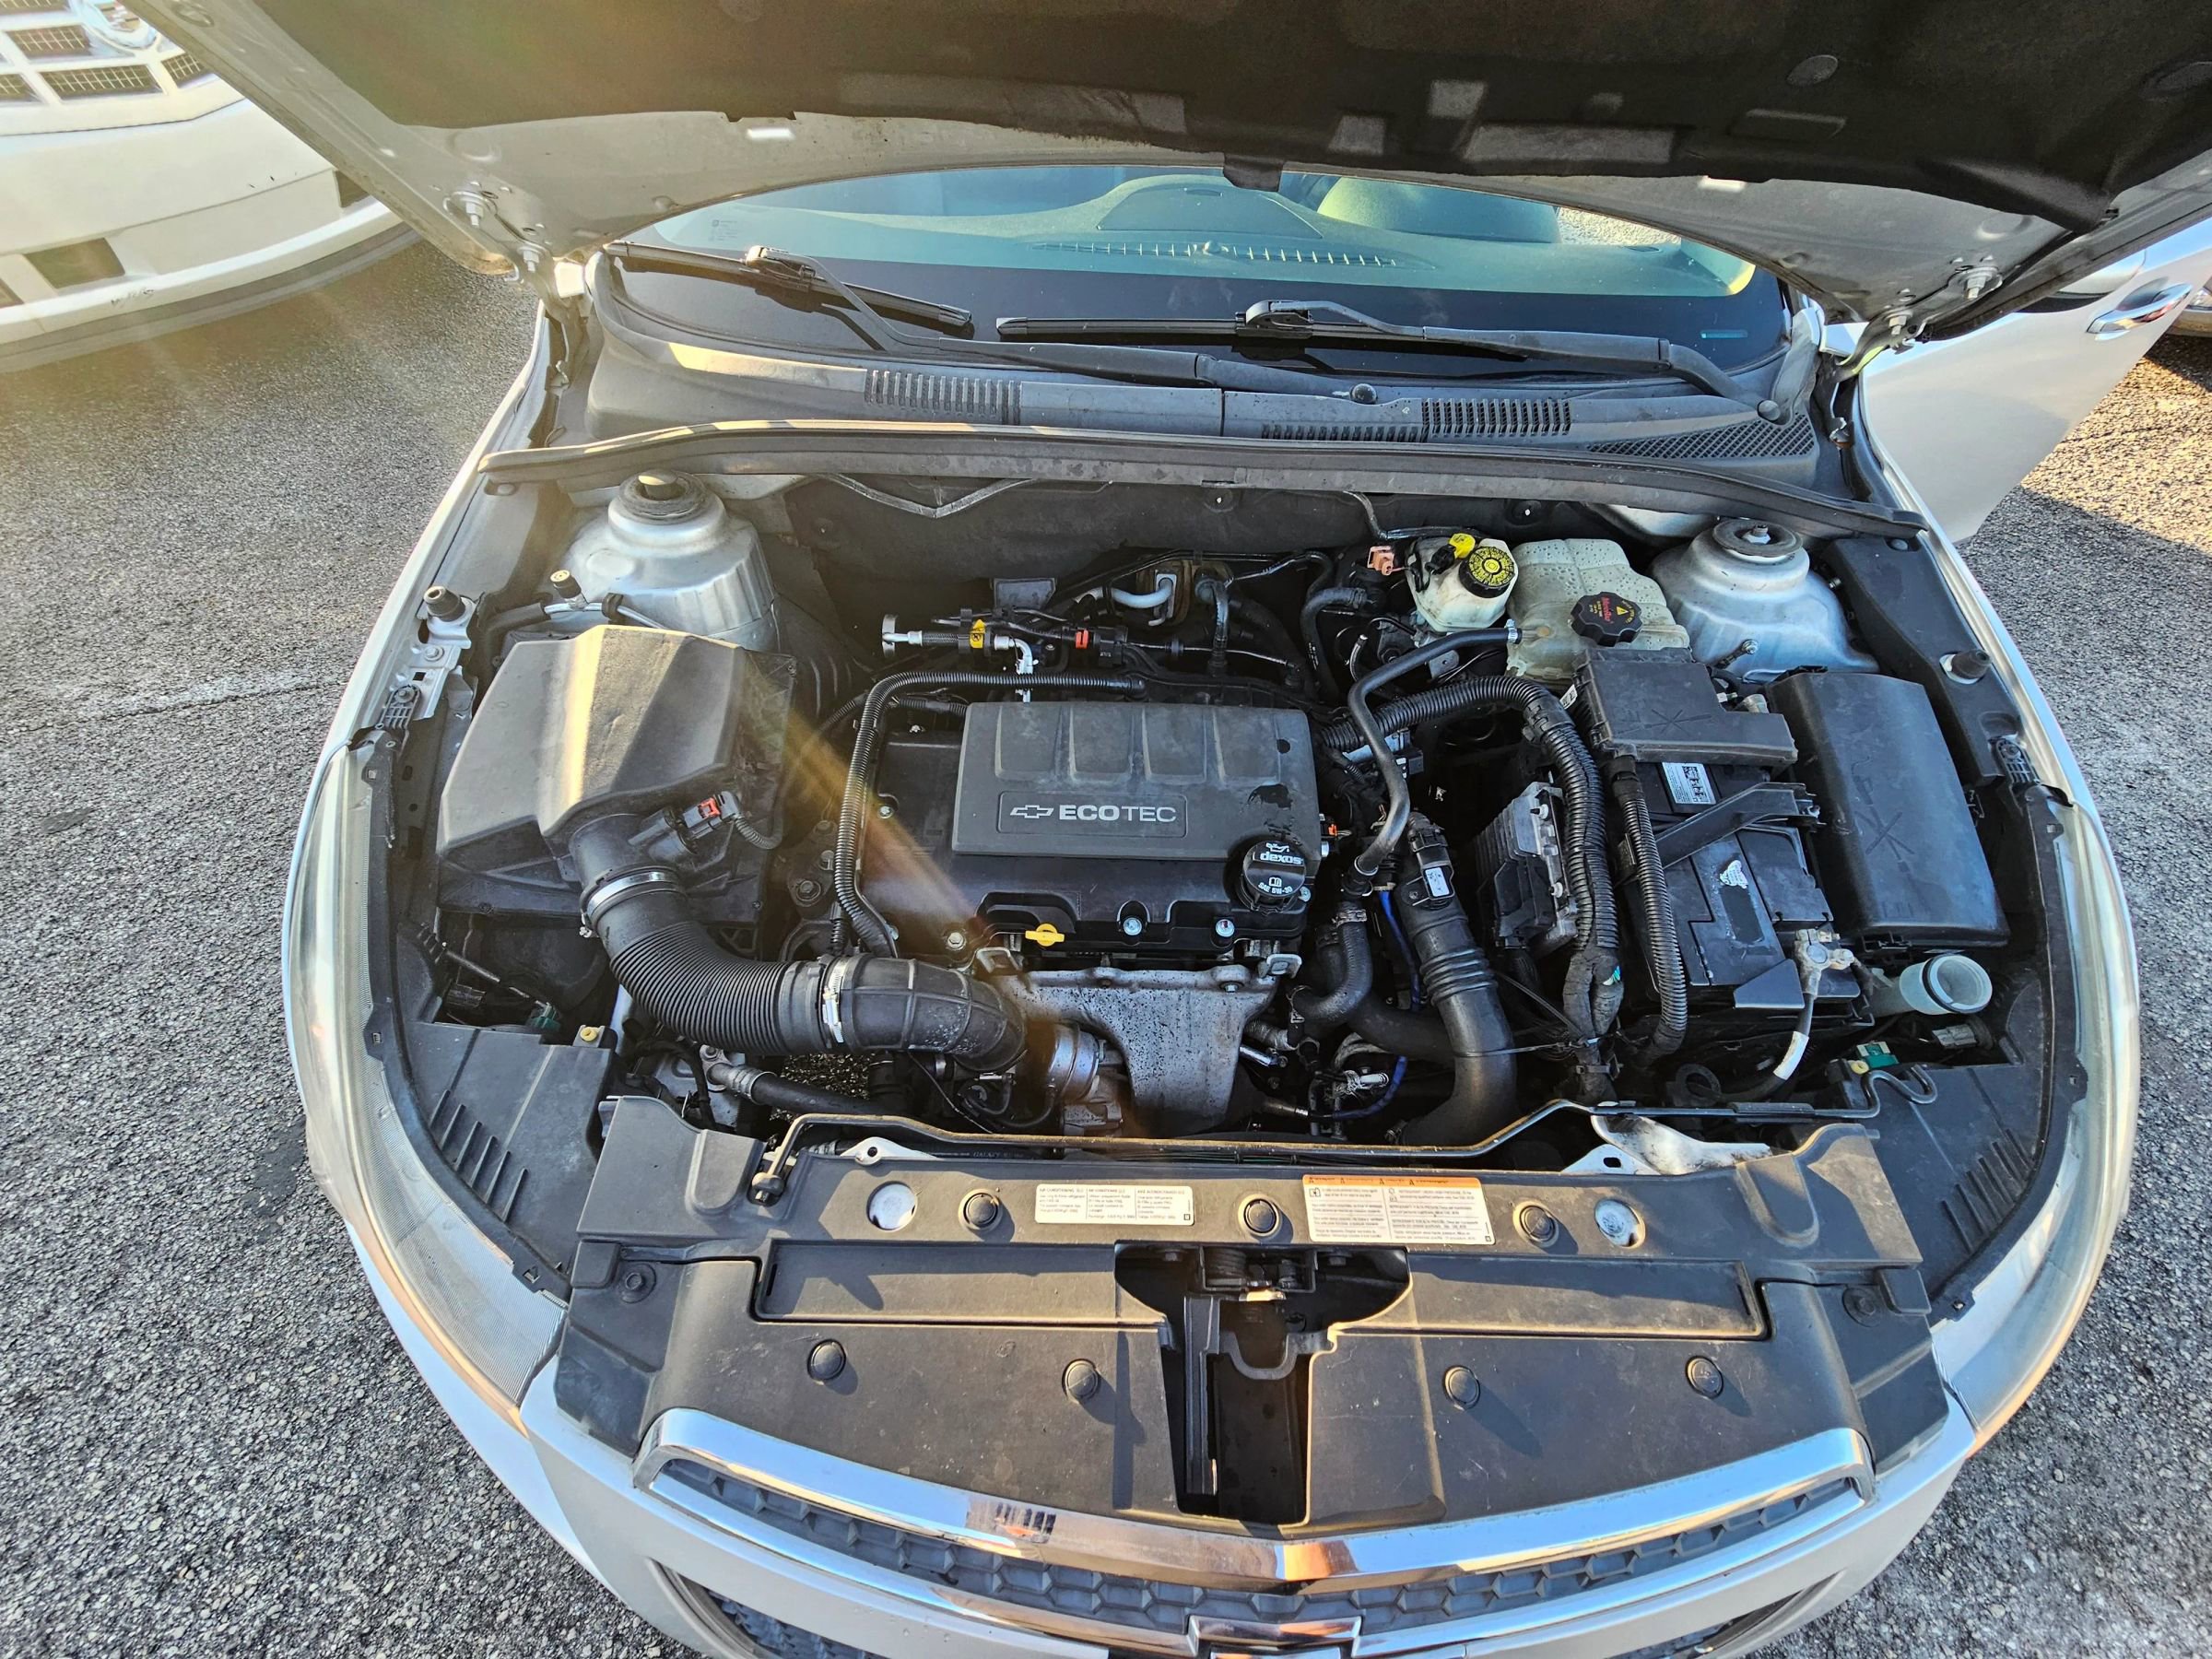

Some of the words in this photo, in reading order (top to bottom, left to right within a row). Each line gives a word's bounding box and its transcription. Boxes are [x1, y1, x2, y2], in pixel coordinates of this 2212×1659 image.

[1059, 805, 1177, 823] ECOTEC
[1260, 851, 1302, 865] dexos
[1258, 882, 1271, 892] SAE
[1272, 886, 1293, 894] 5W-30
